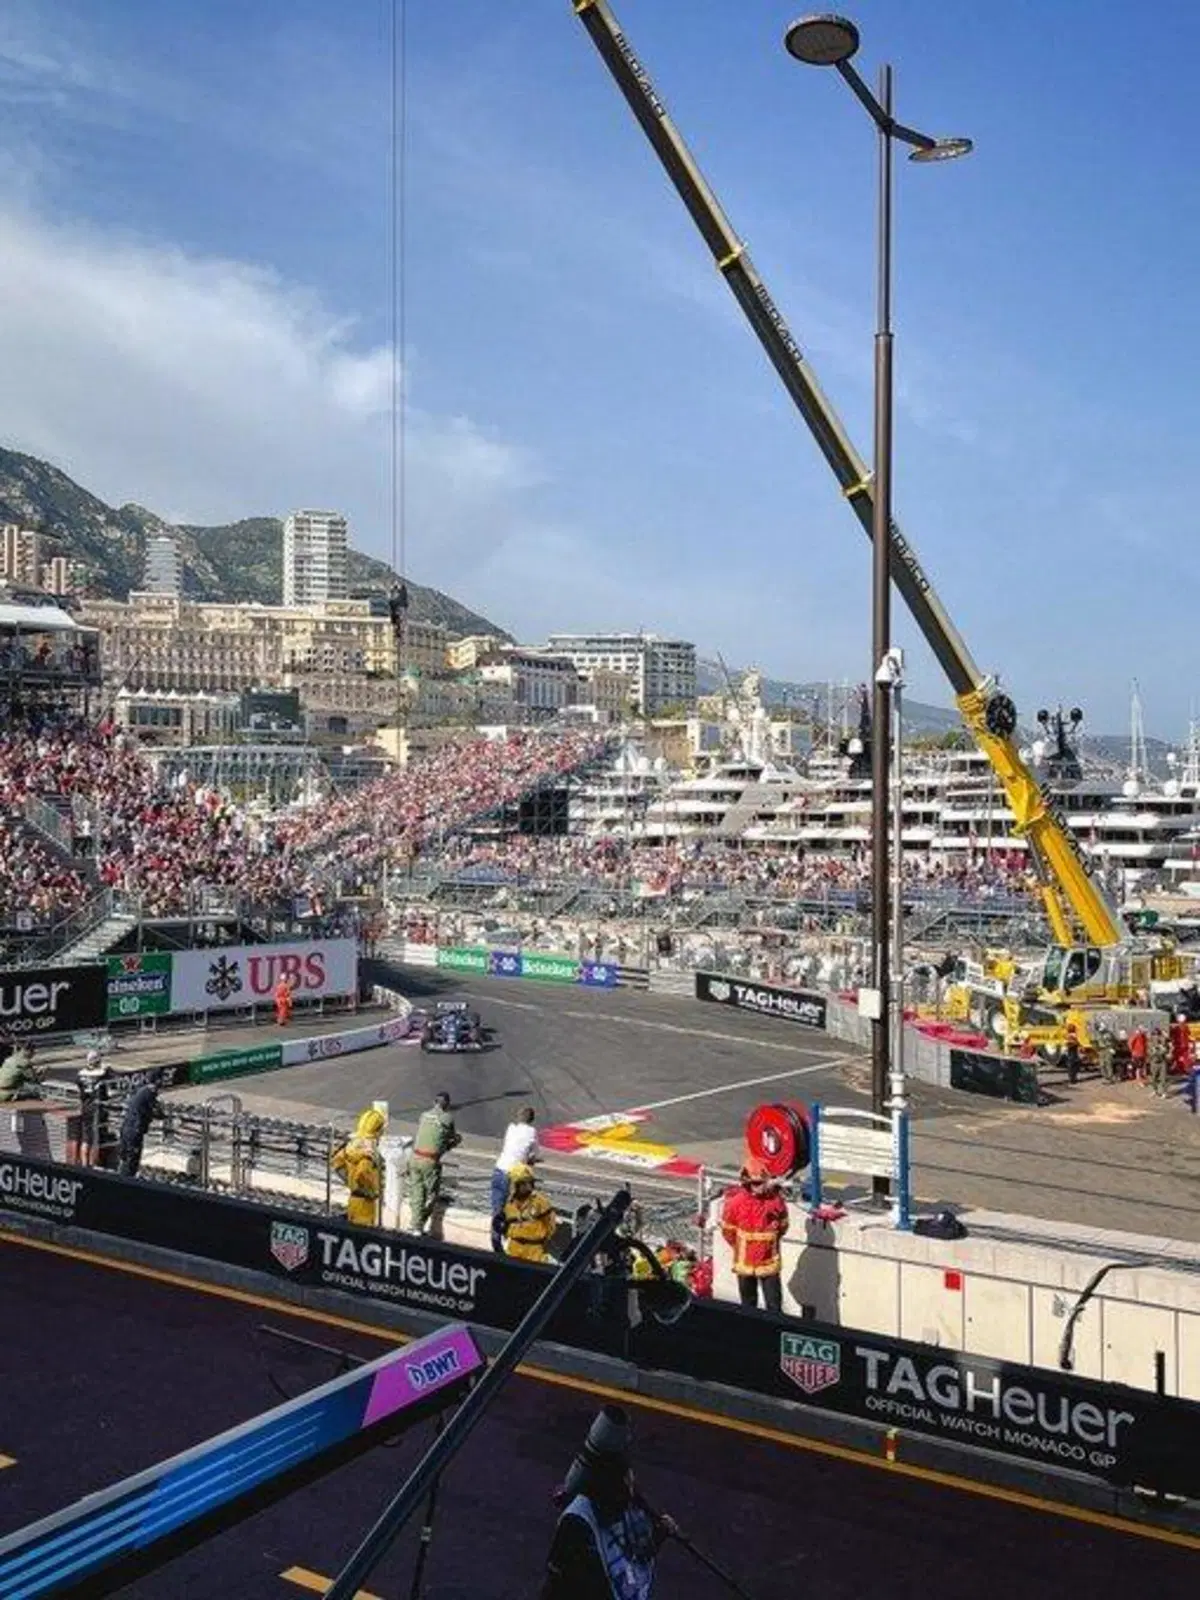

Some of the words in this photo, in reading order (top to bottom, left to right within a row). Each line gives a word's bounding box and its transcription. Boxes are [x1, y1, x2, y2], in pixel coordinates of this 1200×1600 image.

[247, 952, 326, 994] UBS
[423, 1350, 458, 1381] BWT
[787, 1338, 834, 1362] TAG
[784, 1359, 837, 1388] HEUER
[865, 1396, 937, 1426] OFFICIAL
[940, 1414, 1000, 1439] WATCH
[1004, 1429, 1086, 1461] MONACO
[1089, 1451, 1117, 1468] GP
